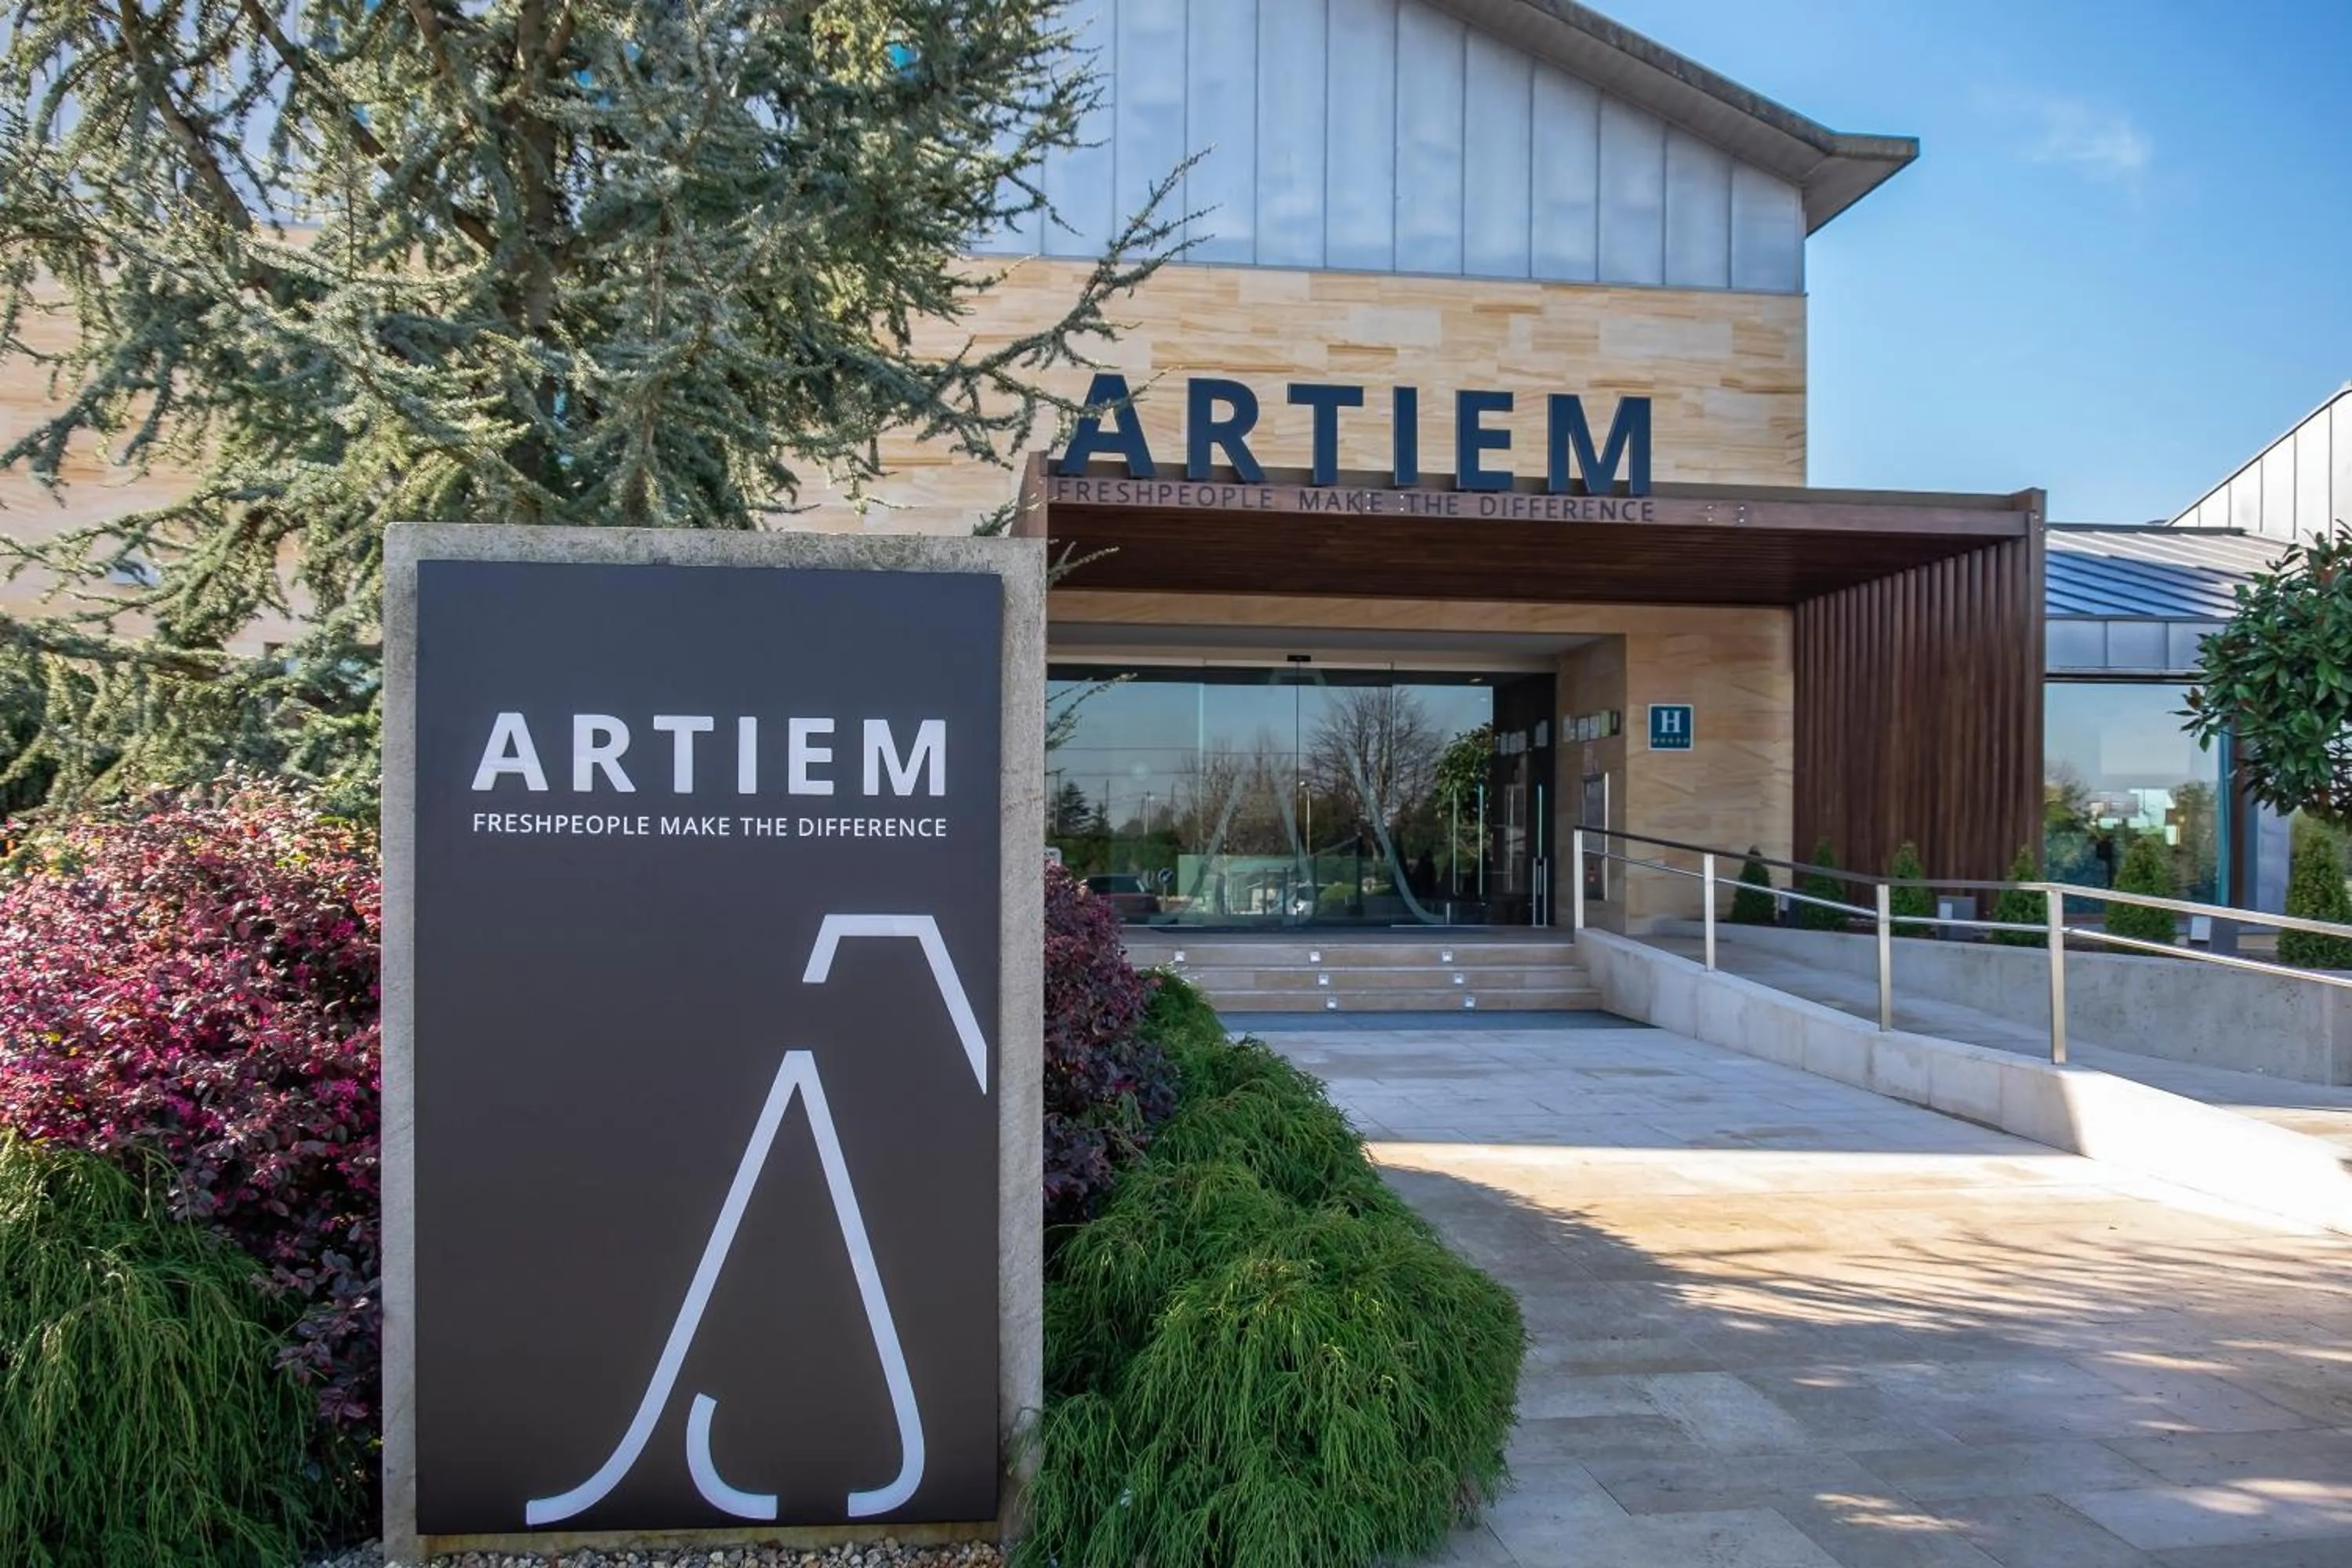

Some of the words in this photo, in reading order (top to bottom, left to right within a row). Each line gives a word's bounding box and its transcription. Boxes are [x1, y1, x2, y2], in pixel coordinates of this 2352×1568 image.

[1060, 372, 1651, 495] ARTIEM
[1056, 481, 1274, 509] FRESHPEOPLE
[1298, 489, 1383, 514] MAKE
[1405, 493, 1459, 516] THE
[1479, 495, 1655, 522] DIFFERENCE
[1661, 710, 1682, 734] H
[472, 712, 946, 797] ARTIEM
[473, 812, 650, 836] FRESHPEOPLE
[660, 816, 731, 837] MAKE
[739, 817, 788, 837] THE
[798, 818, 947, 837] DIFFERENCE
